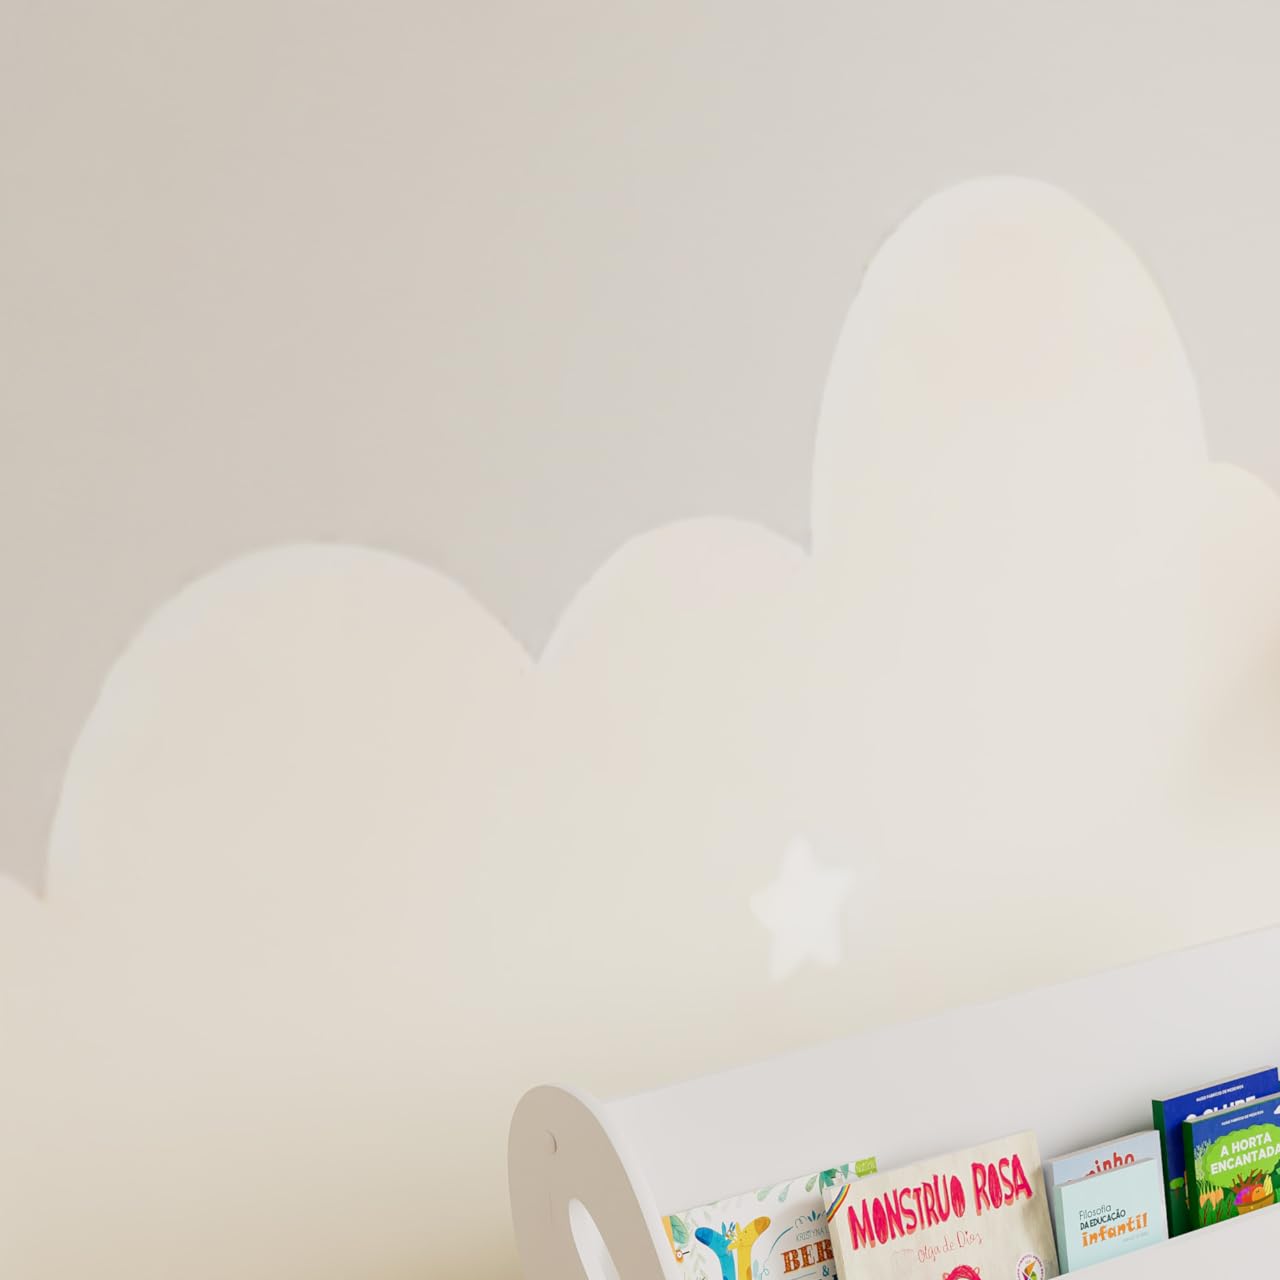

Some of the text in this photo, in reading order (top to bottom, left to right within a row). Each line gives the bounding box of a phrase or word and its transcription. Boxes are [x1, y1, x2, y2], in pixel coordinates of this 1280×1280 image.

[1220, 1131, 1272, 1157] A HORTA
[847, 1153, 1034, 1251] MONSTRUO ROSA
[1079, 1204, 1112, 1221] Filosofia
[1080, 1208, 1127, 1231] DA EDUCAÇÃO
[1081, 1212, 1148, 1248] infantil
[943, 1236, 954, 1252] de
[956, 1230, 984, 1249] Dios
[821, 1264, 830, 1278] &
